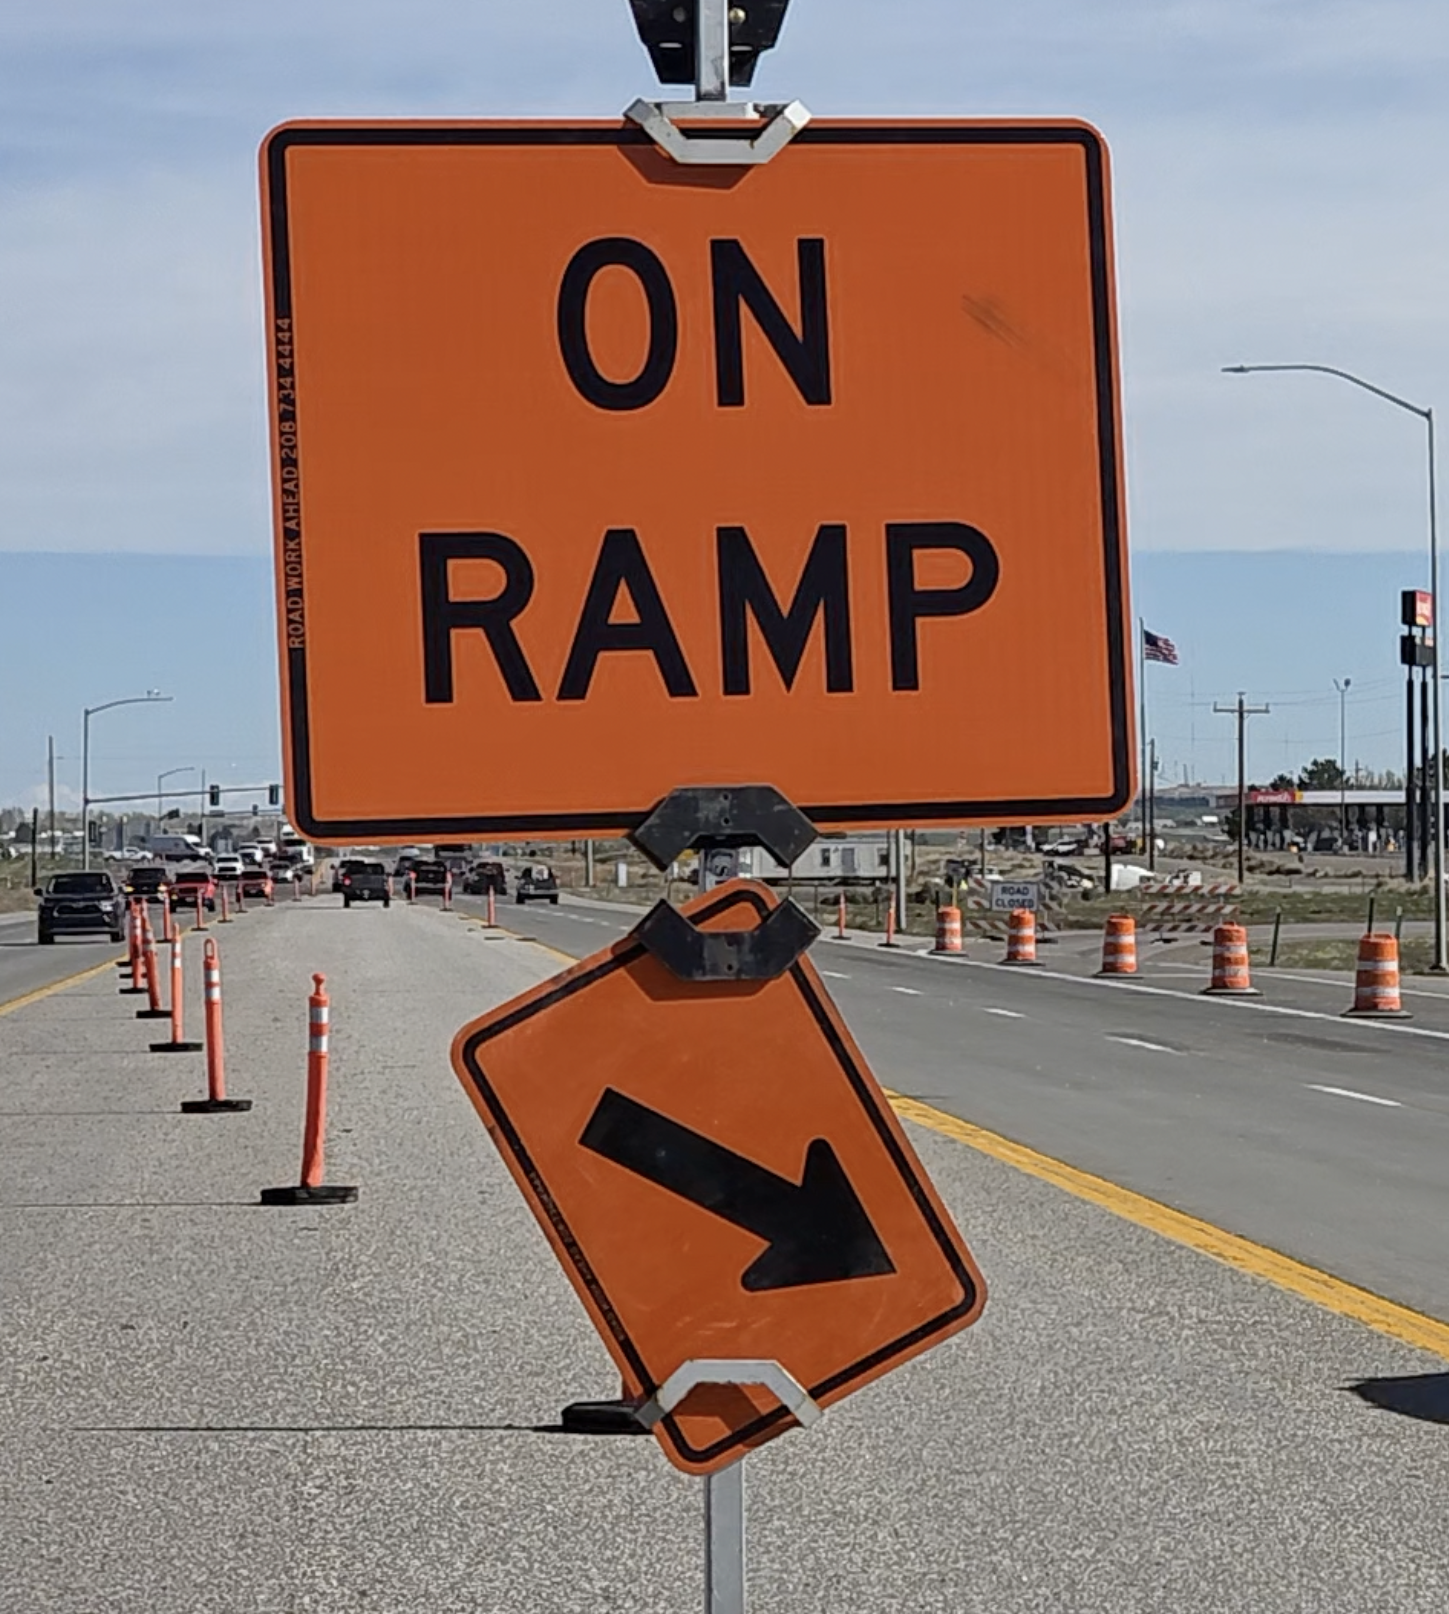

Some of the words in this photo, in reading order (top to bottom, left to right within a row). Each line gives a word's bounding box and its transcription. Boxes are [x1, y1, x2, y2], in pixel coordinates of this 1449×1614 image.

[276, 318, 292, 370] 4444
[557, 236, 833, 411] ON
[278, 377, 295, 413] 734
[280, 420, 298, 459] 208
[282, 466, 299, 531] AHEAD
[285, 538, 303, 590] WORK
[287, 596, 305, 649] ROAD
[418, 522, 1000, 703] RAMP
[995, 898, 1034, 908] CLOSED
[1001, 886, 1030, 896] ROAD
